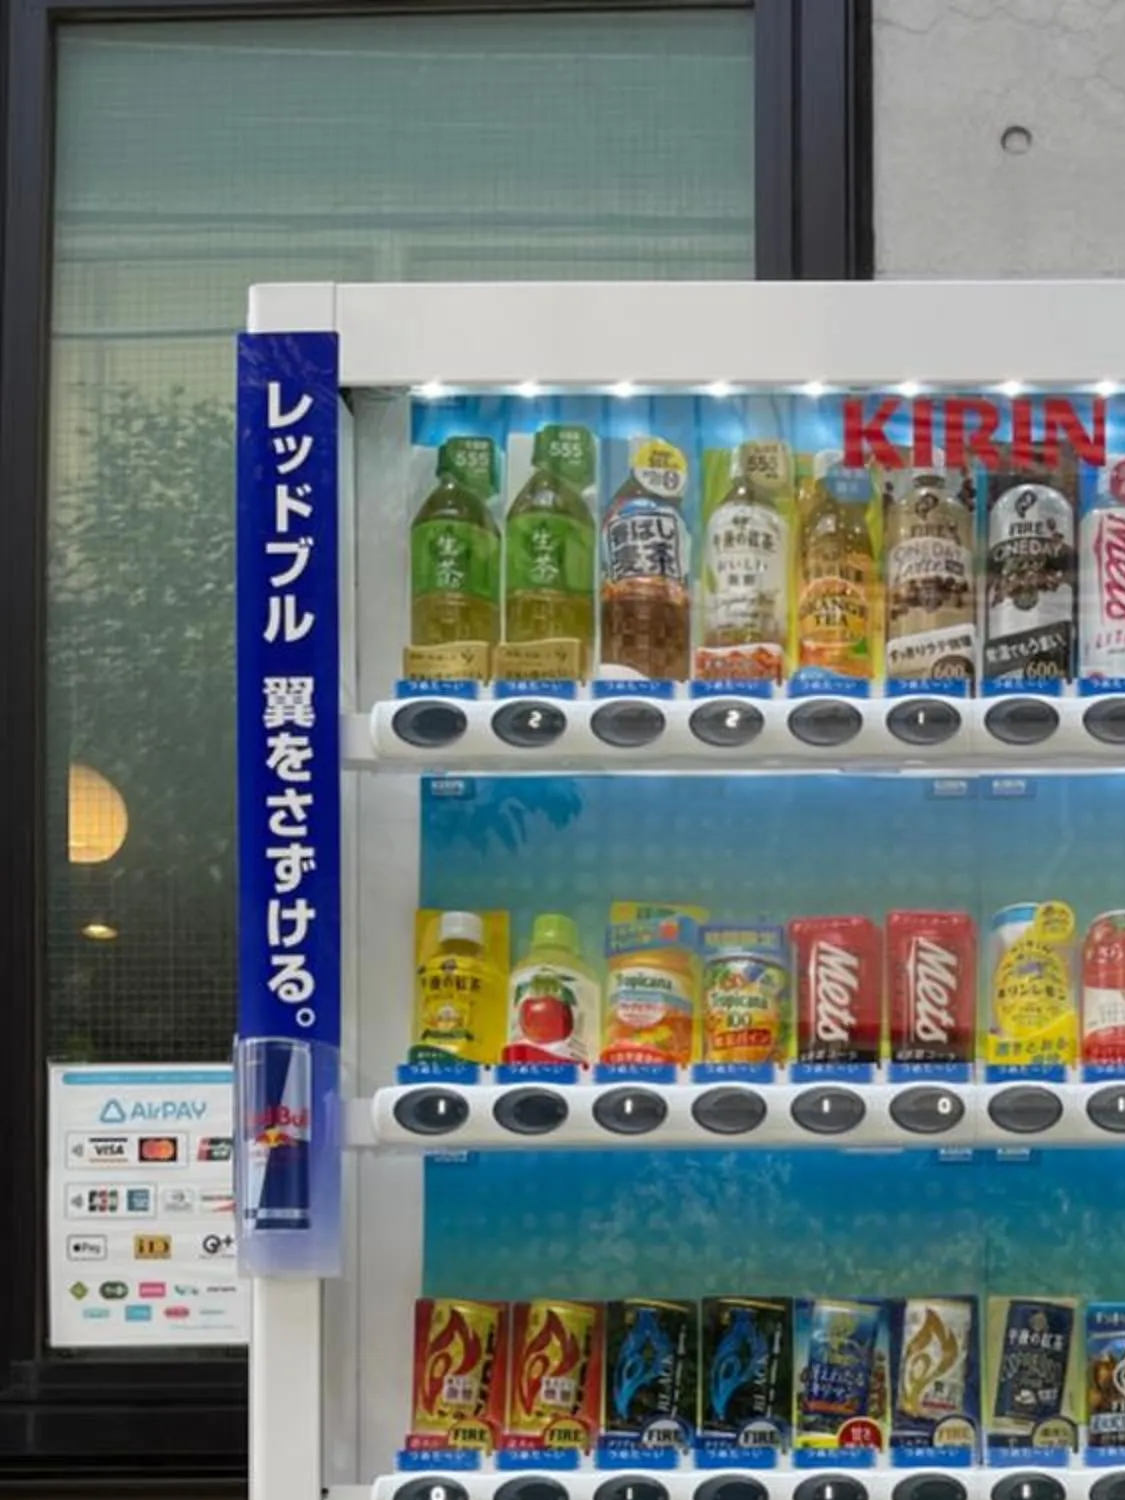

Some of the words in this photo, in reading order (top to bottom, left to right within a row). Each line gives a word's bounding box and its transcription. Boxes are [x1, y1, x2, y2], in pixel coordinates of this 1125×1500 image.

[843, 395, 1107, 469] KIRIN
[263, 381, 314, 643] レッドブル
[437, 535, 465, 588] 生茶
[531, 528, 559, 584] 生茶
[263, 676, 317, 1028] 翼をさずける。
[817, 940, 860, 1042] Mets
[917, 936, 959, 1044] Mets
[95, 1144, 125, 1156] VISA
[647, 1429, 682, 1442] FIRE
